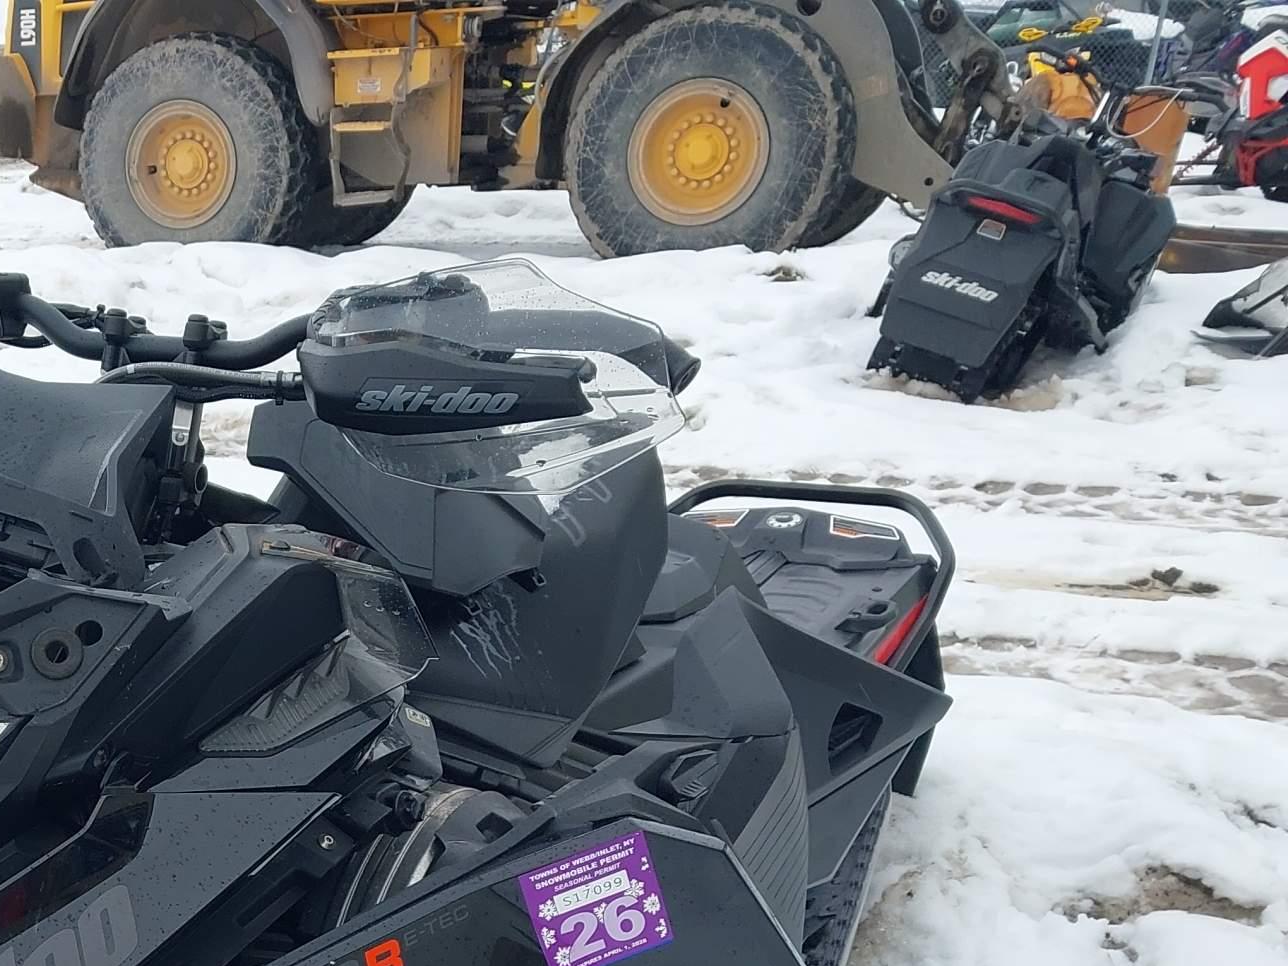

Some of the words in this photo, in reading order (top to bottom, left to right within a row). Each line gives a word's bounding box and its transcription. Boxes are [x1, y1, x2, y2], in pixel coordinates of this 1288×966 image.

[20, 9, 36, 46] L90H
[921, 271, 999, 302] ski-doo
[355, 385, 519, 414] ski-doo
[529, 868, 559, 882] TOWNS
[559, 862, 571, 871] OF
[623, 837, 635, 848] NY
[535, 861, 598, 890] SNOWMOBILE
[600, 847, 634, 866] PERMIT
[554, 874, 593, 892] SEASONAL
[594, 862, 621, 878] PERMIT
[562, 877, 623, 907] S17099
[404, 904, 470, 947] E-TEC
[560, 895, 646, 964] 26
